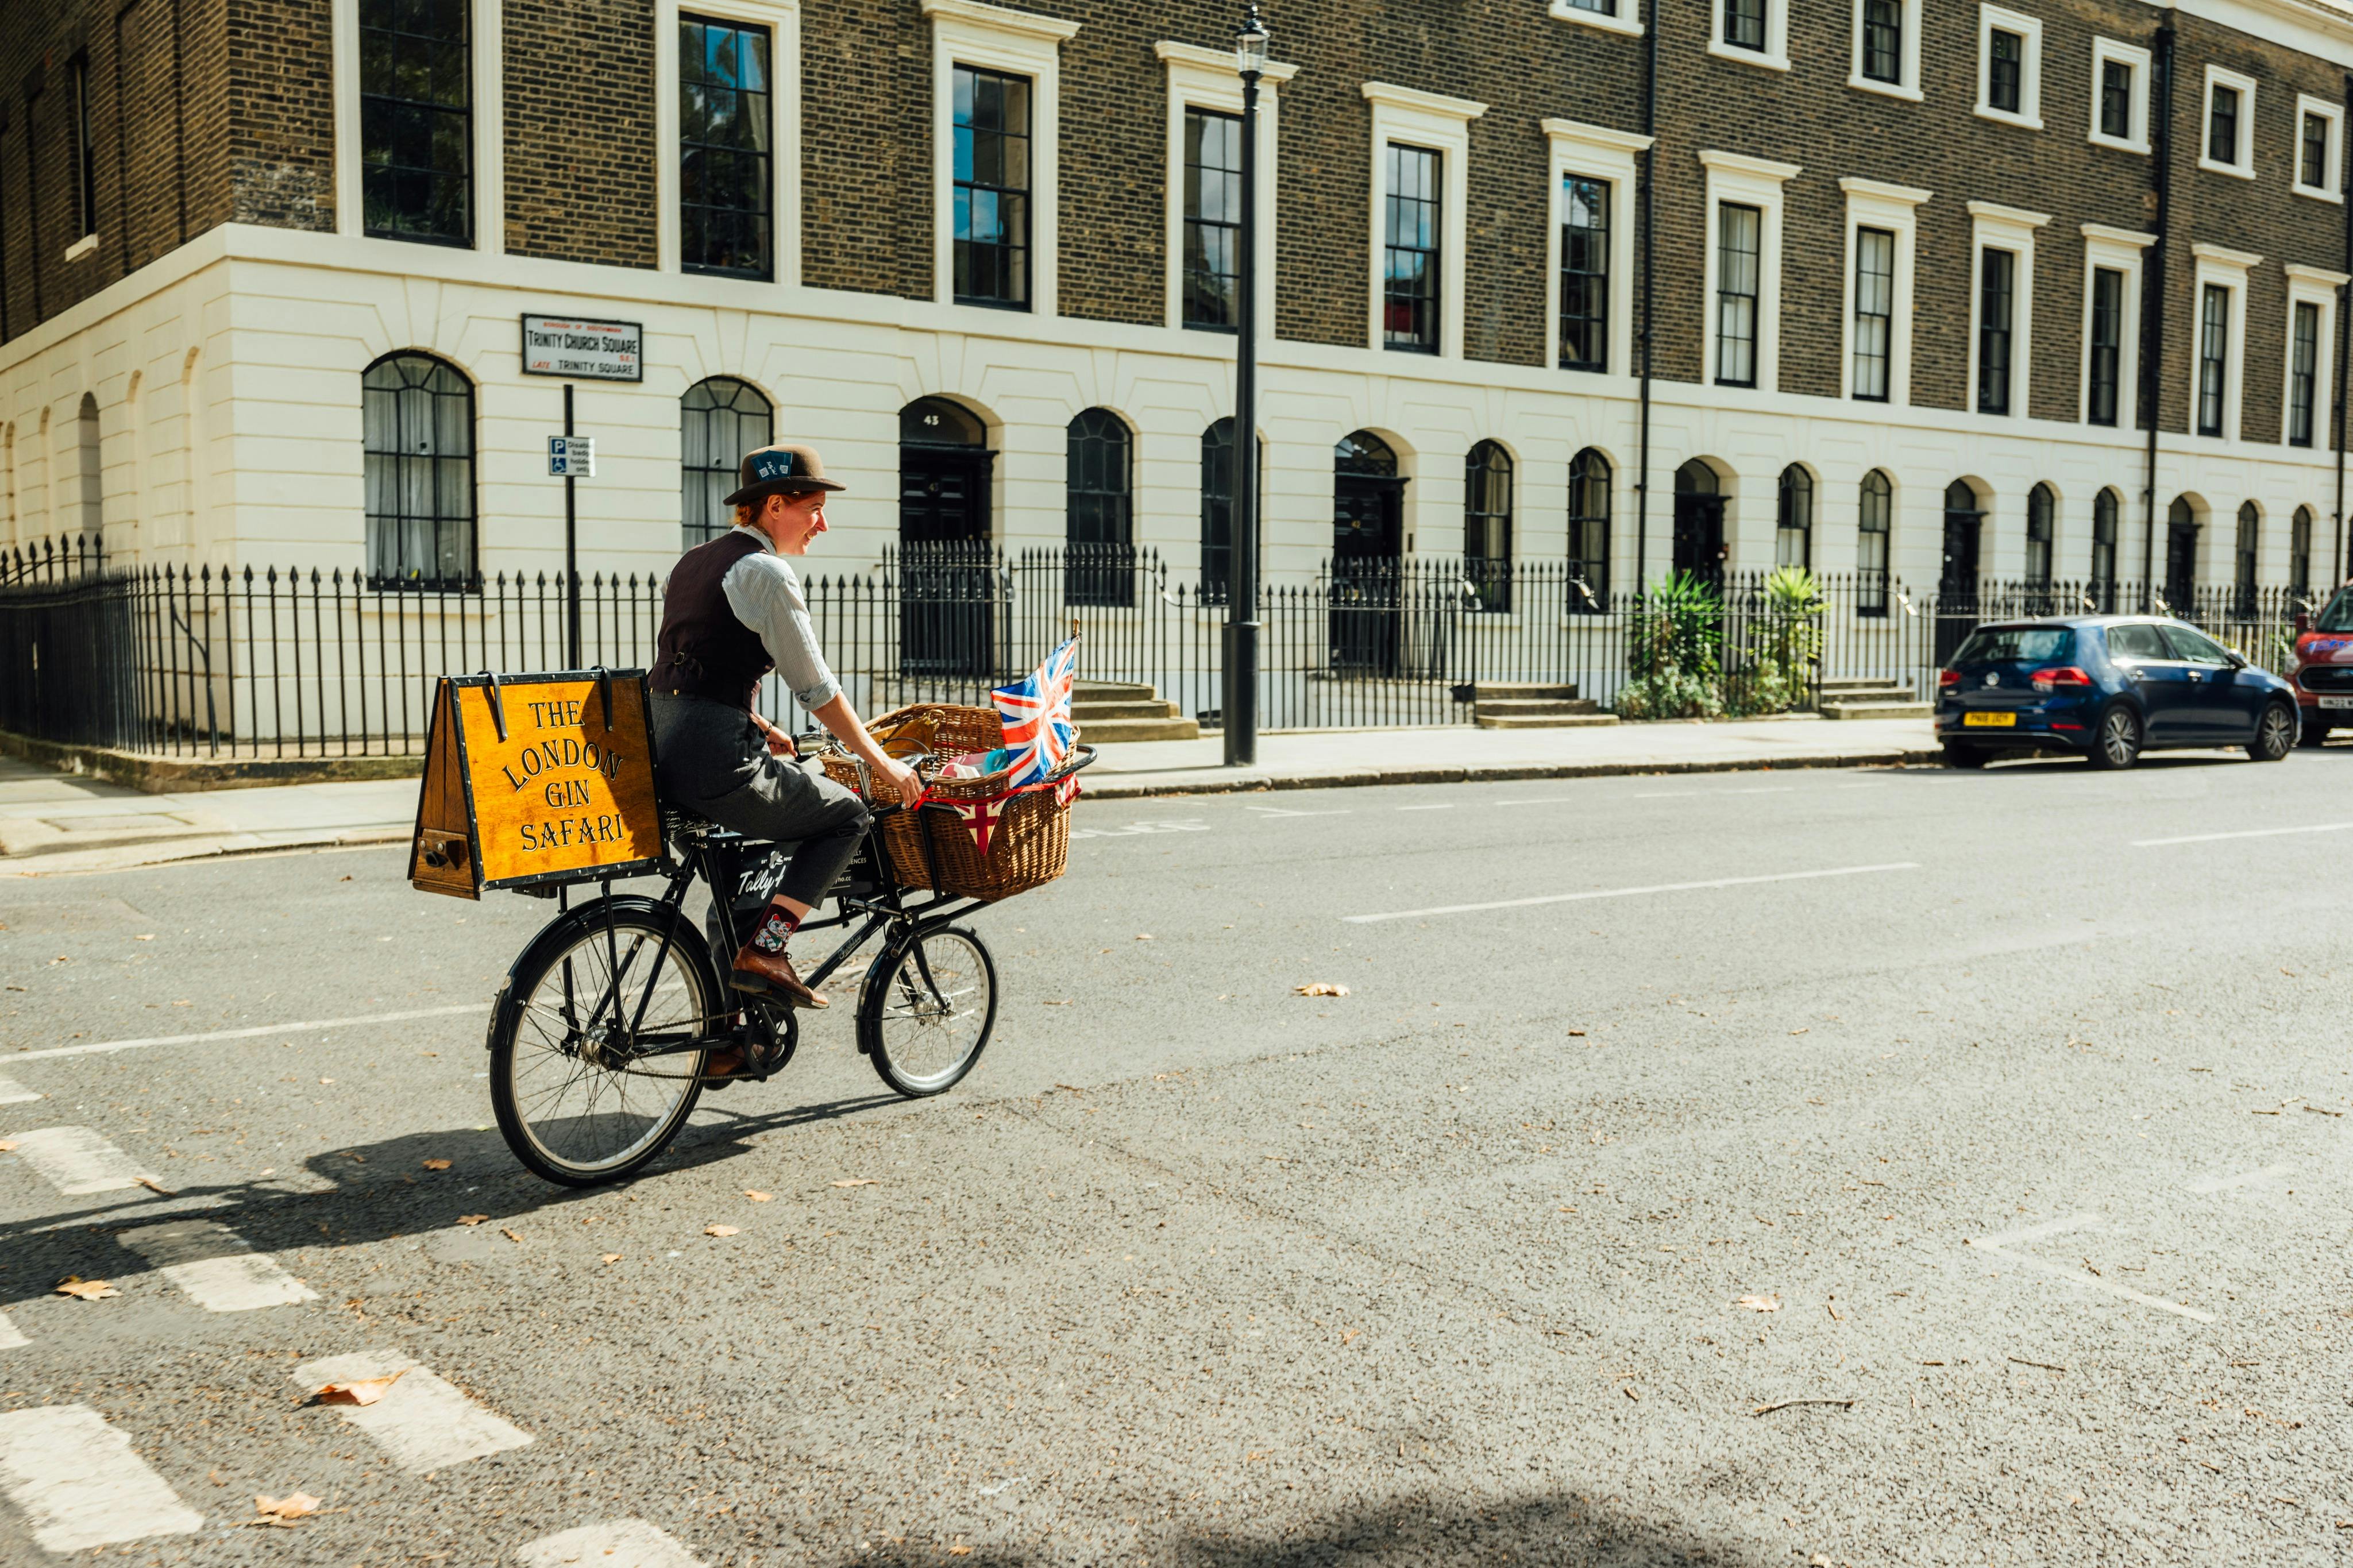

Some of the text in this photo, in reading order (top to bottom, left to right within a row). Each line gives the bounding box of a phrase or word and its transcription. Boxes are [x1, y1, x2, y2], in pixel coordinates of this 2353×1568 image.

[527, 330, 637, 354] TRINITY CHURCH SQUARE
[532, 360, 634, 374] LATE TRINITY SQUARE
[924, 415, 939, 426] 43
[554, 441, 564, 453] P
[1352, 520, 1361, 528] 42
[529, 700, 585, 729] THE
[502, 738, 624, 793] LONDON
[545, 779, 592, 809] GIN
[521, 814, 625, 853] SAFARI
[738, 869, 774, 900] Tally
